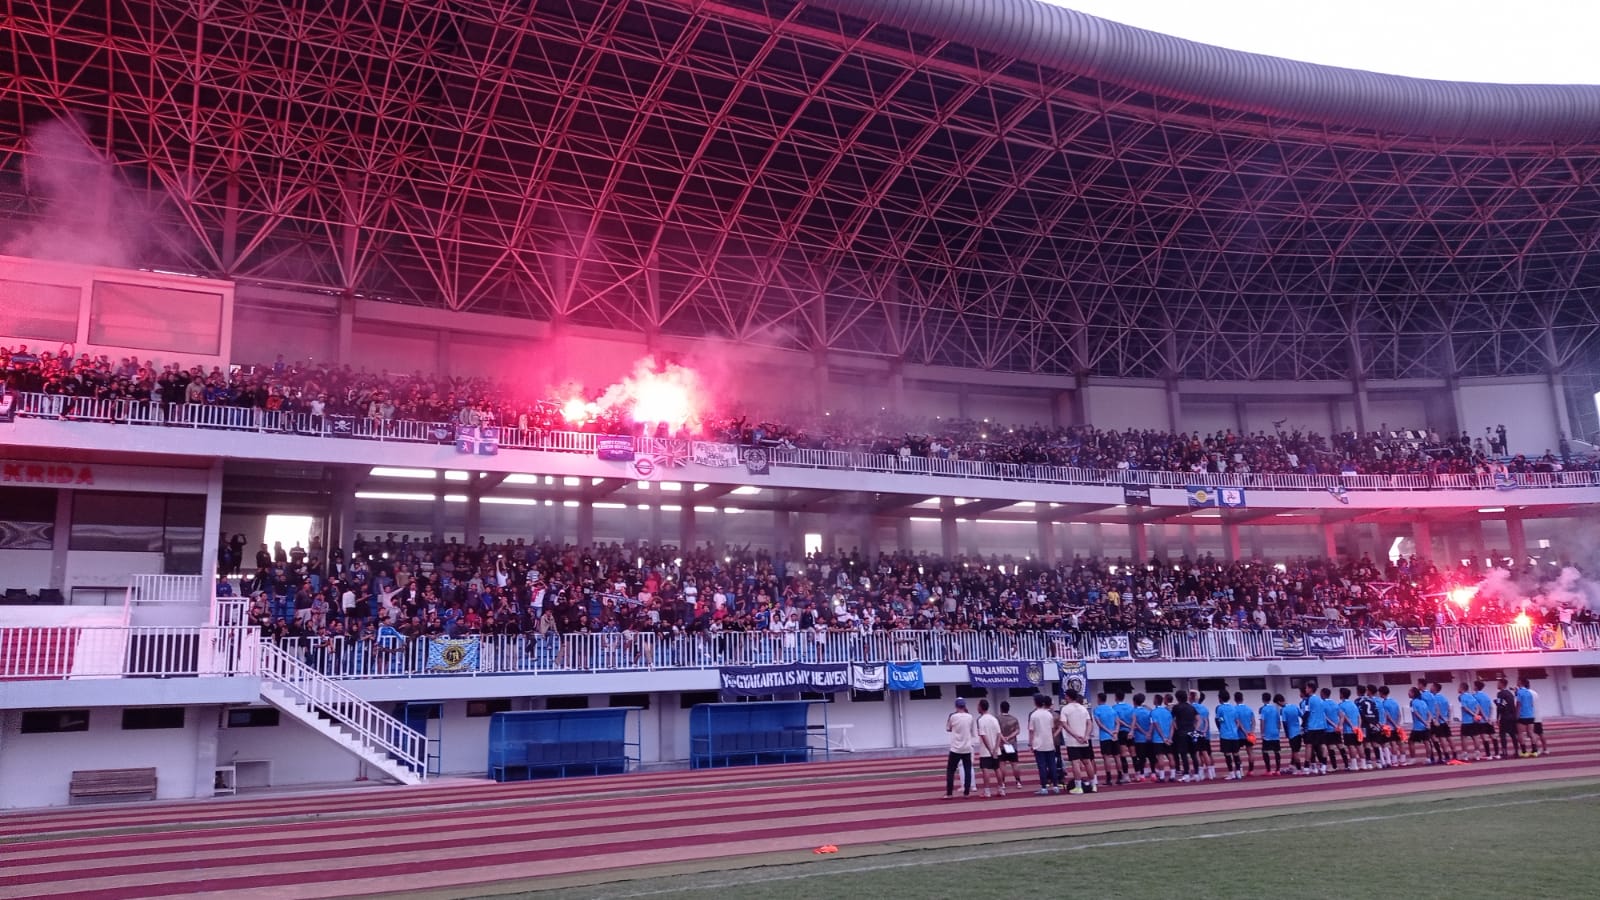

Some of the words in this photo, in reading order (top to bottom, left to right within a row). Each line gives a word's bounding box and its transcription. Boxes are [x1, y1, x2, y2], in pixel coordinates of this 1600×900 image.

[3, 463, 94, 485] KRIDA
[722, 671, 785, 689] YOGYAKARTA
[785, 671, 796, 685] IS
[796, 670, 810, 685] MY
[811, 671, 848, 686] HEAVEN
[1364, 701, 1373, 715] 2
